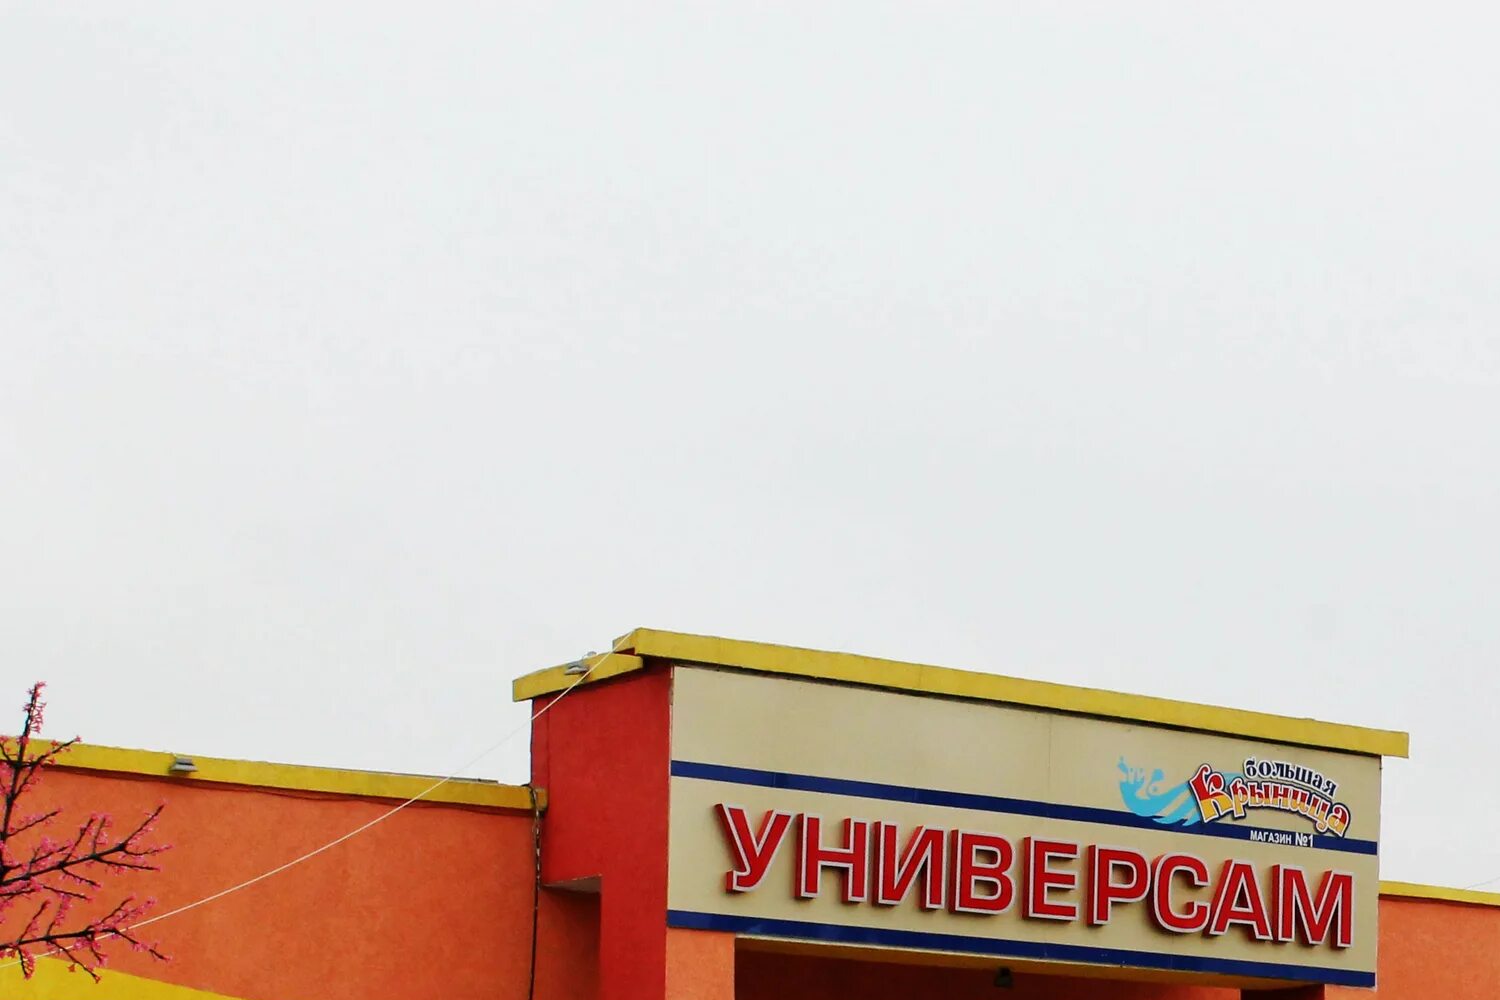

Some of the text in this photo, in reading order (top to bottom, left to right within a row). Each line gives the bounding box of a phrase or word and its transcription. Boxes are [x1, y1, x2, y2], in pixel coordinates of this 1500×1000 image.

[1188, 763, 1351, 839] Крыница
[1243, 757, 1339, 797] большая
[1249, 830, 1315, 848] МАГАЗИН №1
[714, 802, 1355, 950] УНИВЕРСАМ
